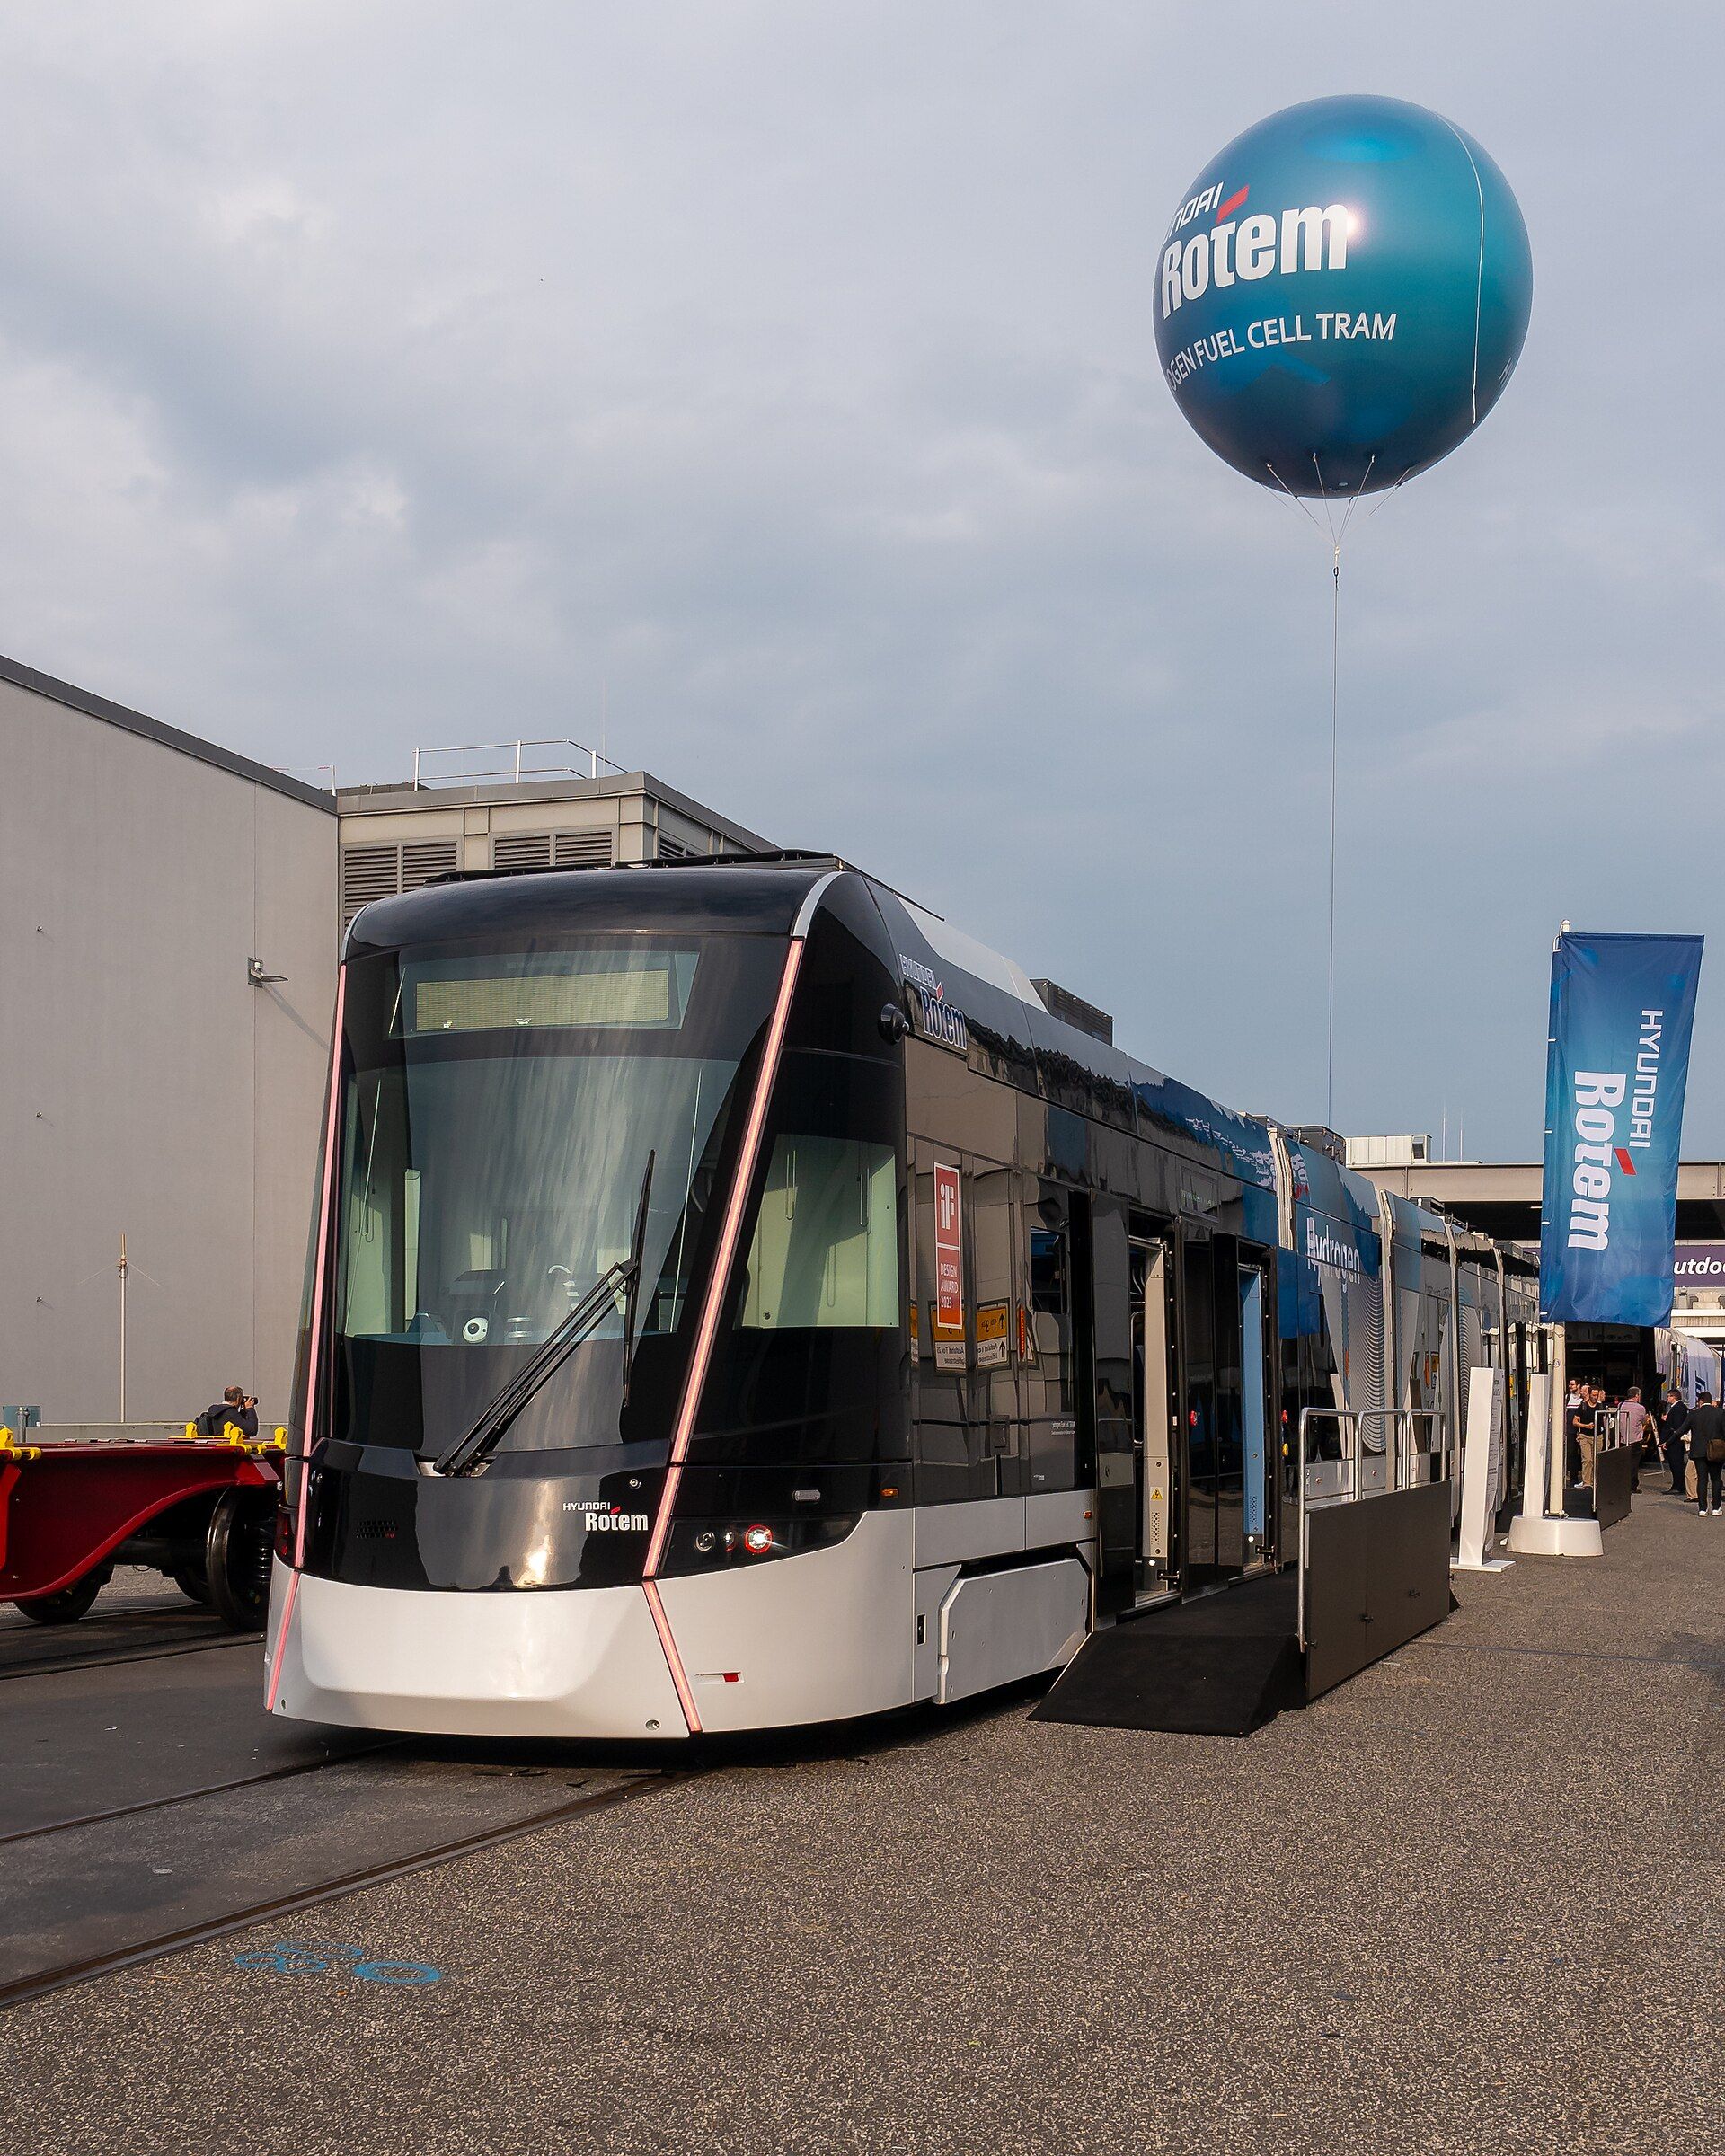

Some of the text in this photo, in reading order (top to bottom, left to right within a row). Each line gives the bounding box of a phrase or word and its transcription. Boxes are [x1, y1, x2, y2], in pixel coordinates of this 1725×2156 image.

[1167, 181, 1224, 238] NDAI
[1162, 204, 1349, 320] Rotem
[1166, 312, 1397, 393] OGEN FUEL CELL TRAM
[920, 986, 967, 1050] Rotem
[1629, 1009, 1664, 1148] HYUNDAI
[1567, 1070, 1627, 1251] Rotem
[940, 1262, 958, 1278] DESIGN
[1306, 1217, 1360, 1294] Hydrogen
[1674, 1256, 1725, 1275] utdo
[940, 1280, 959, 1294] AWARD
[941, 1296, 952, 1309] 2023
[562, 1502, 611, 1511] HYUNDAI
[585, 1512, 649, 1531] Rotem
